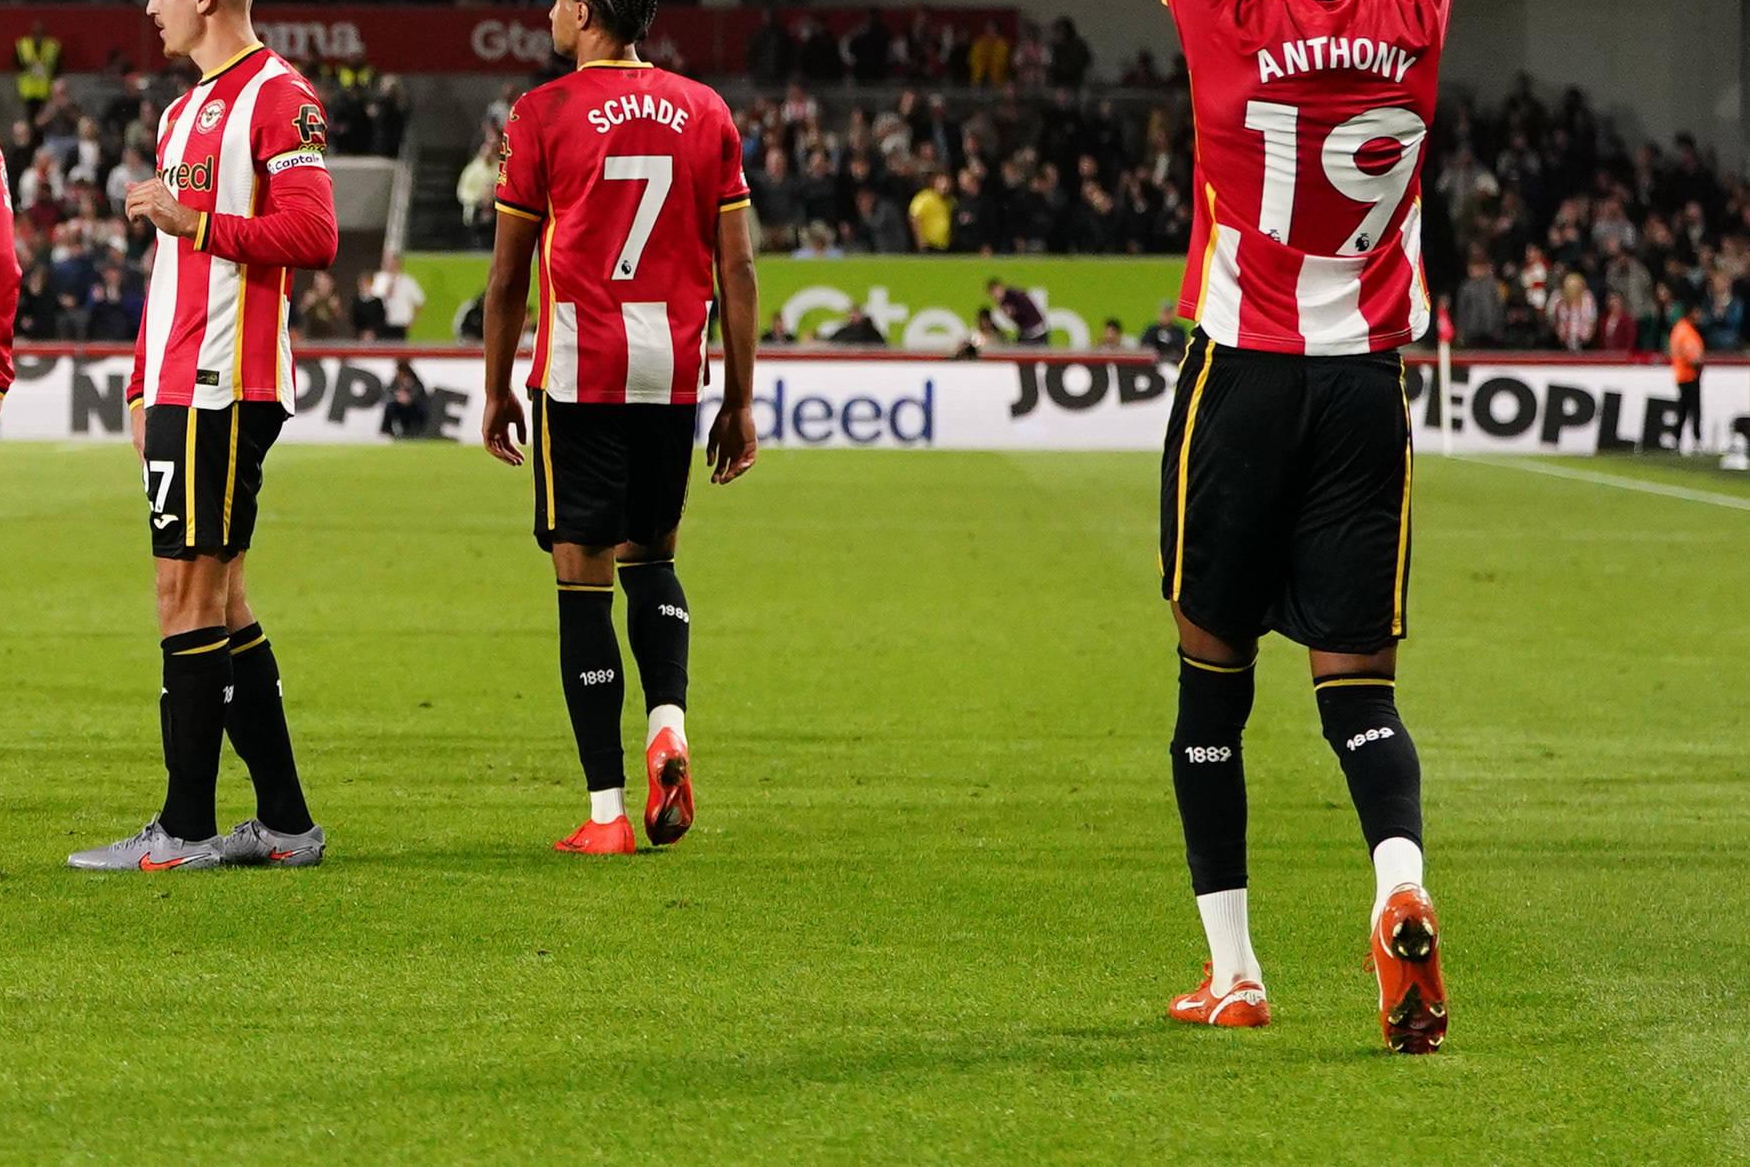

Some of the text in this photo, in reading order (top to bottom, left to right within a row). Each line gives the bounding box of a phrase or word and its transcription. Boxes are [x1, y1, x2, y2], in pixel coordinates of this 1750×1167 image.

[1258, 36, 1416, 84] ANTHONY
[587, 94, 689, 134] SCHADE
[1244, 100, 1427, 257] 19
[603, 155, 673, 280] 7
[143, 460, 175, 513] 7
[657, 603, 690, 624] 1889
[579, 668, 615, 686] 1889
[1184, 746, 1232, 764] 1889
[1346, 726, 1395, 751] 1889
